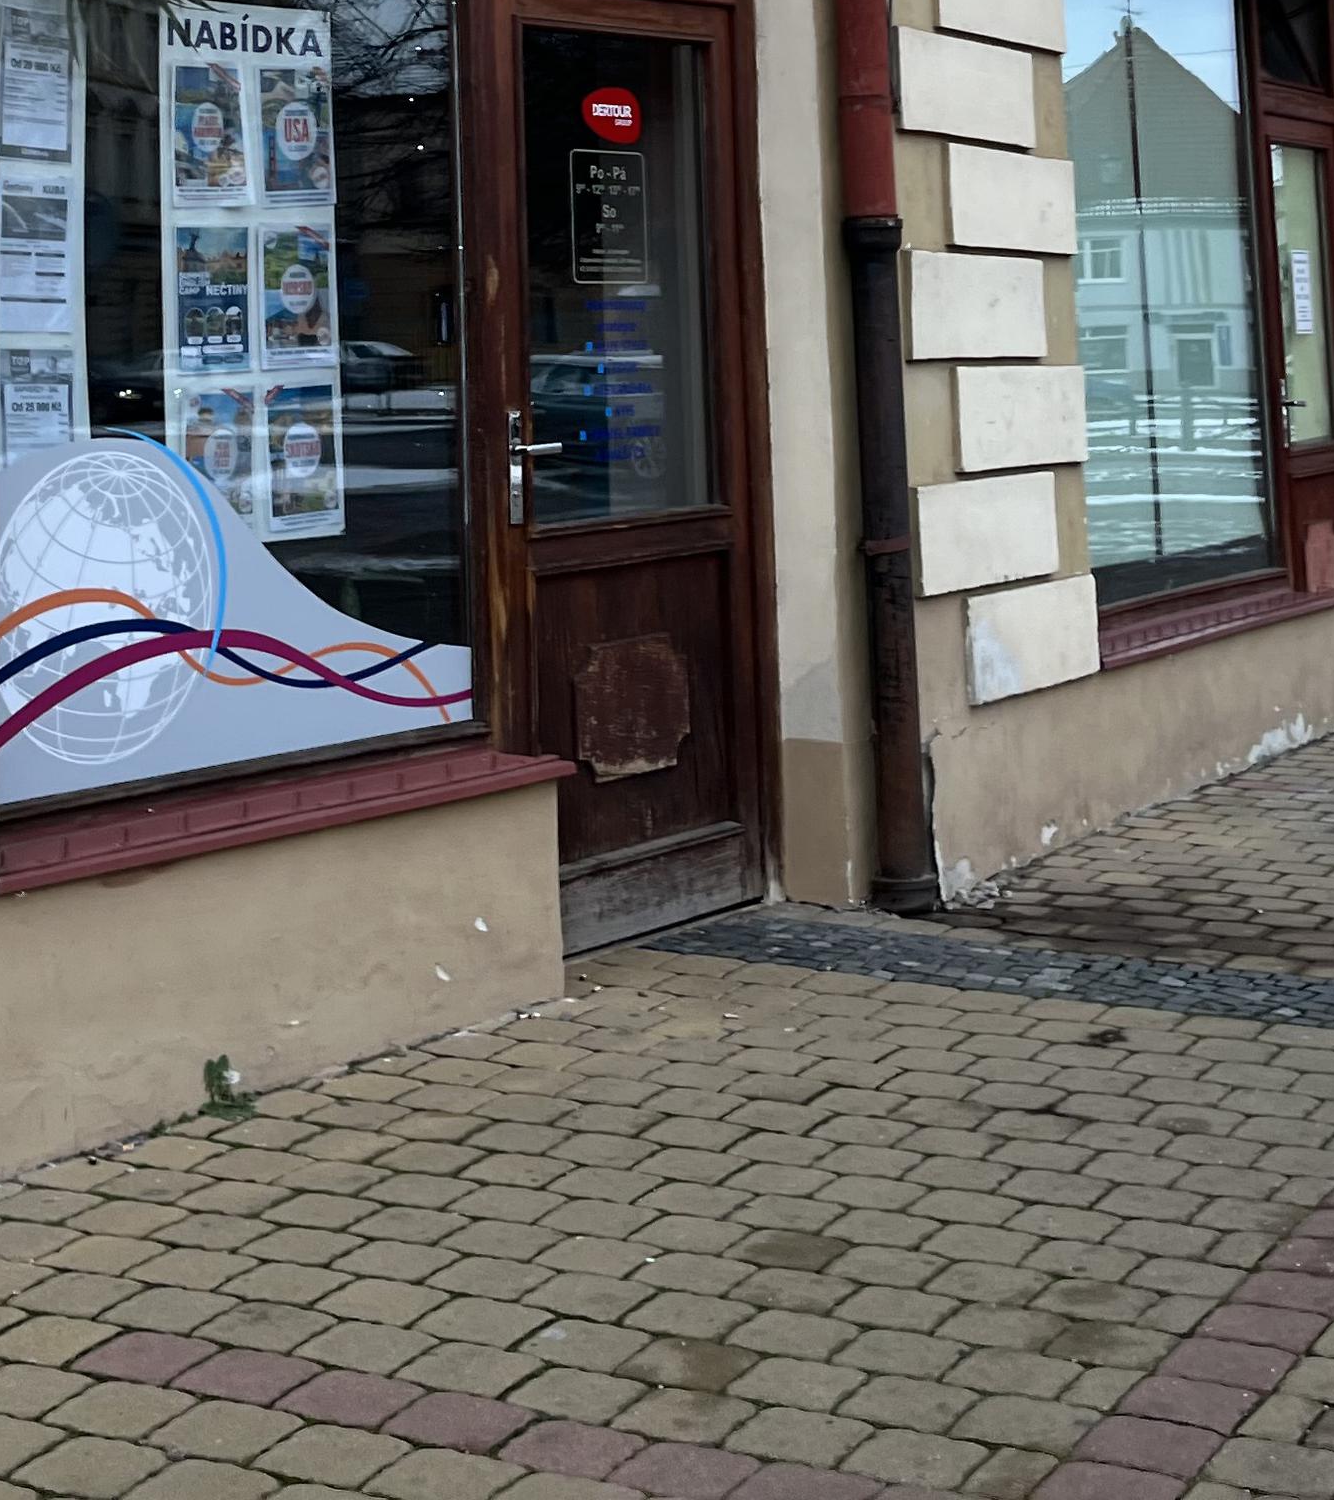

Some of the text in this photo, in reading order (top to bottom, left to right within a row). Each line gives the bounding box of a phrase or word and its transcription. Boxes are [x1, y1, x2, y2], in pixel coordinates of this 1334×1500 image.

[167, 13, 324, 58] NABÍDKA
[284, 117, 309, 143] USA
[601, 203, 617, 219] So
